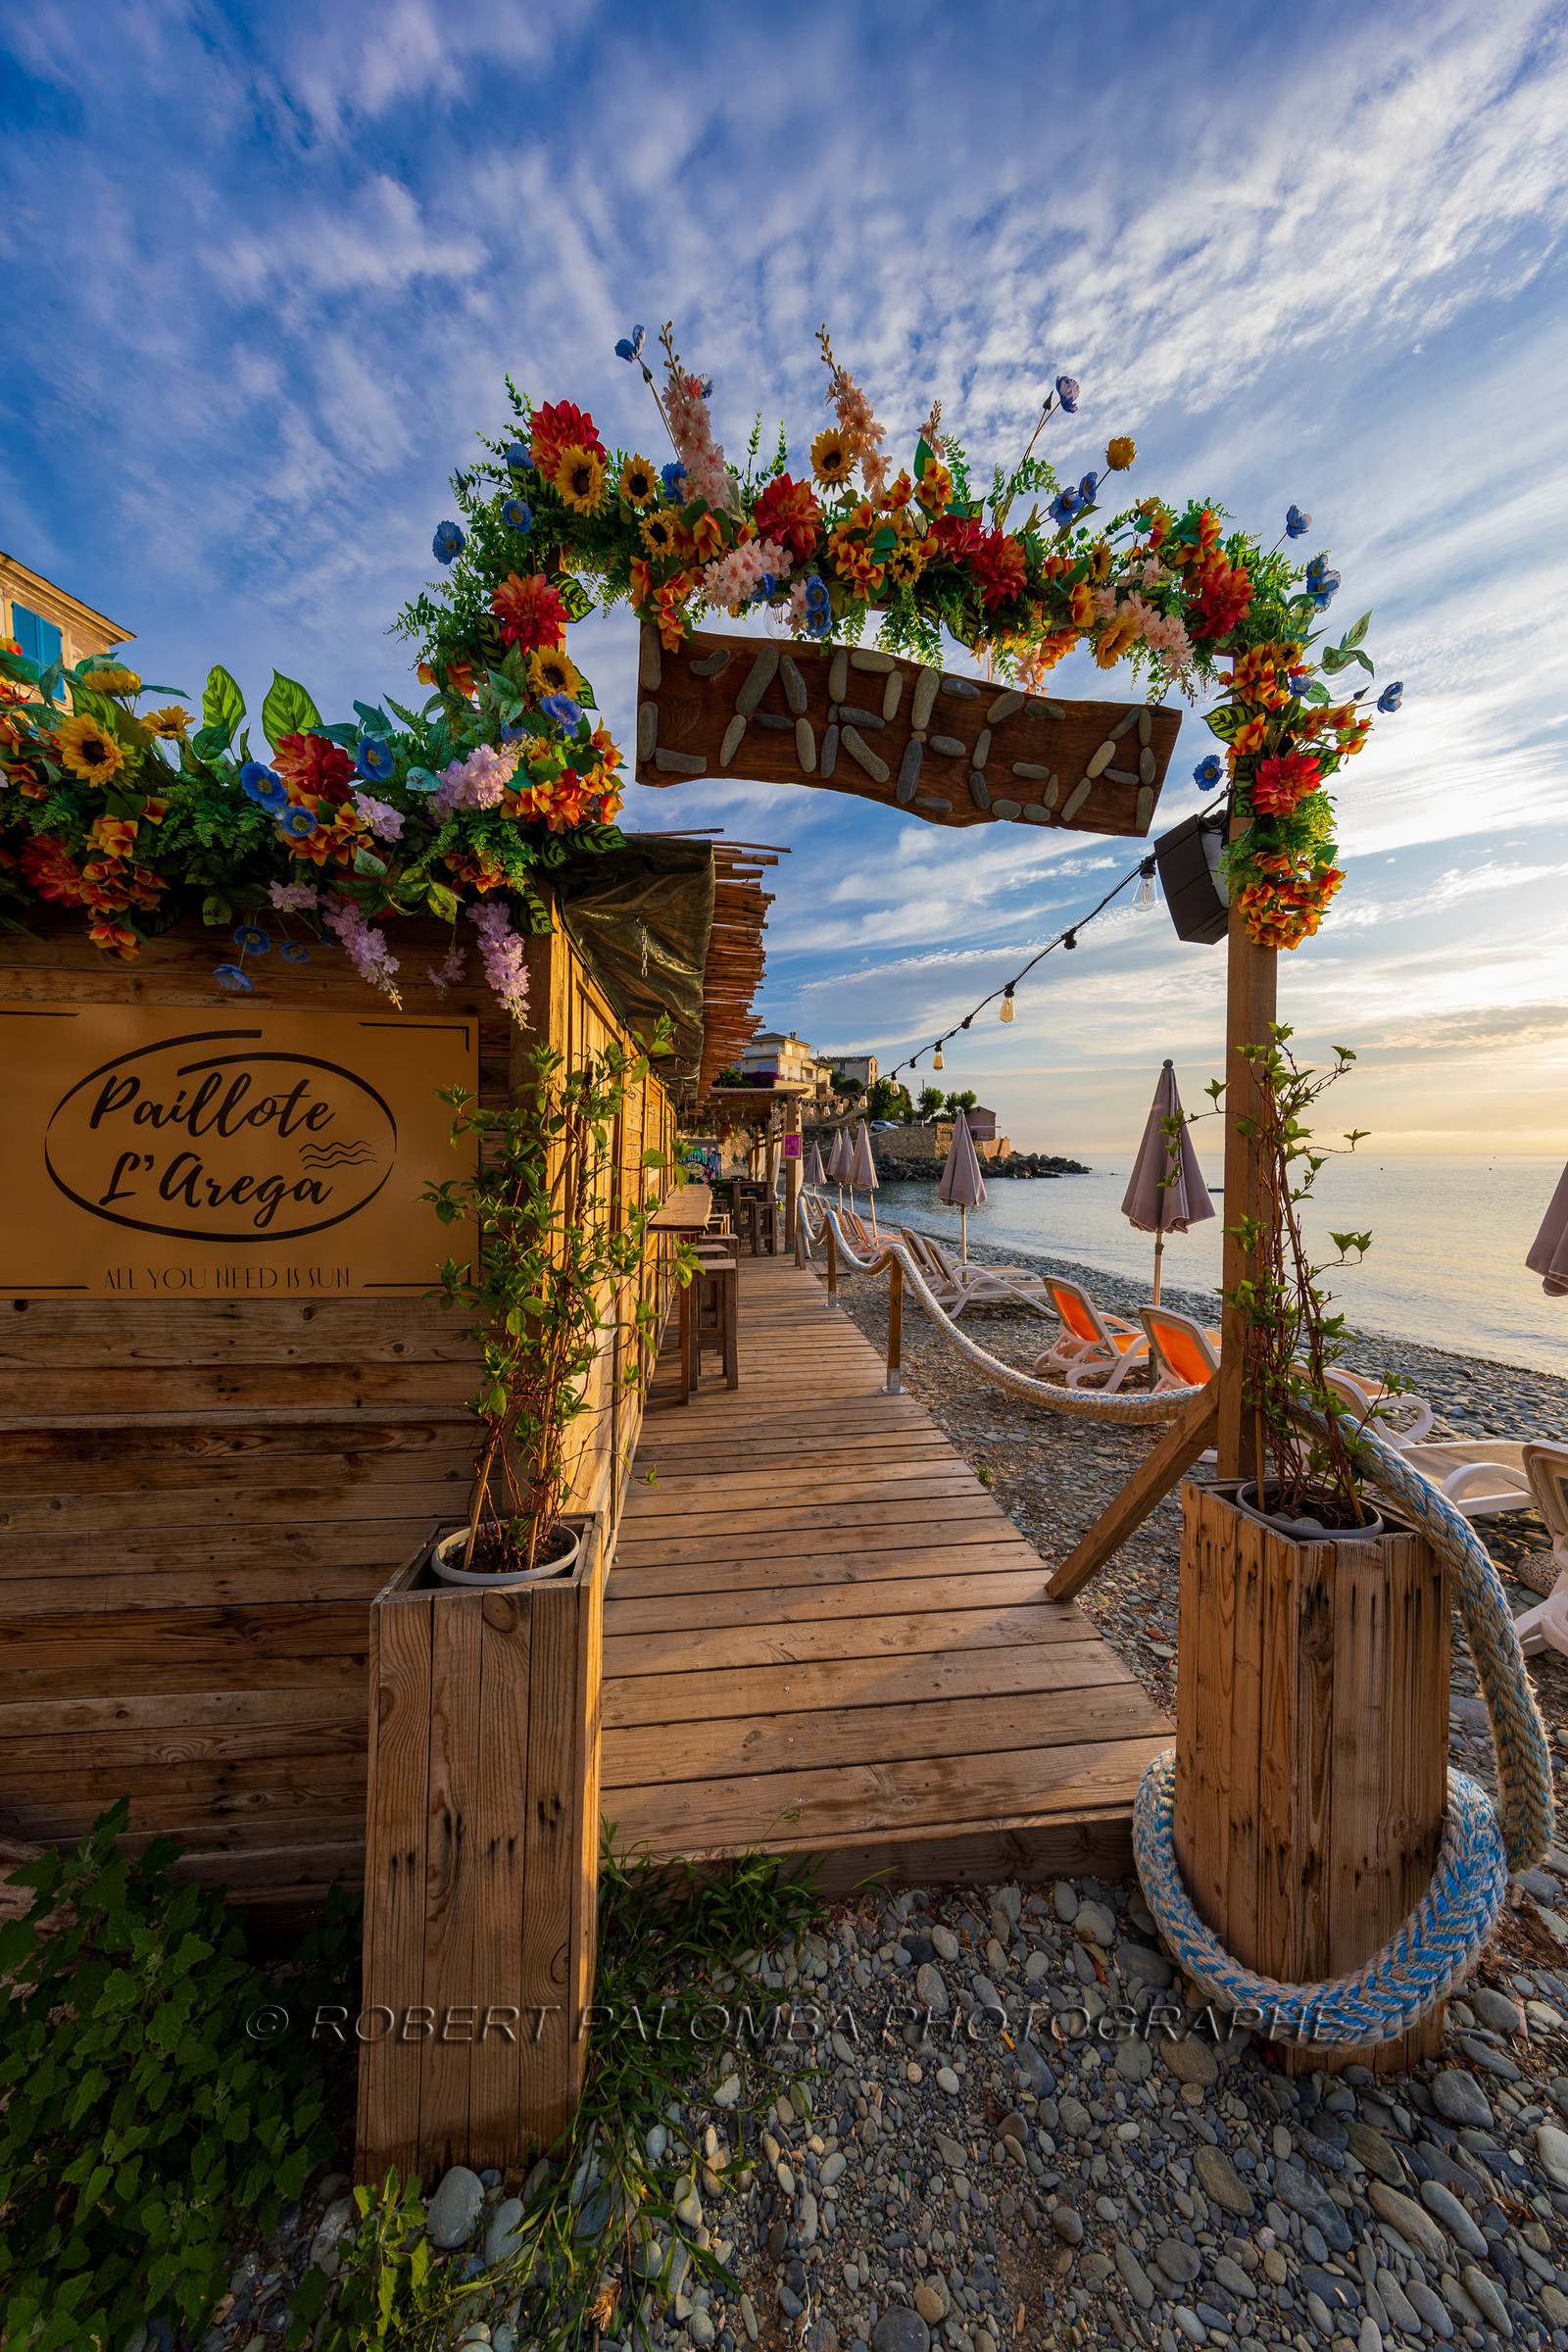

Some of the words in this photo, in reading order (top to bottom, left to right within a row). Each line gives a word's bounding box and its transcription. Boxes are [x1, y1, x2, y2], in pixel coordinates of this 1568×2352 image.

[90, 1072, 335, 1138] Paillote
[99, 1152, 333, 1228] L'Arega
[105, 1268, 139, 1290] ALL
[147, 1267, 207, 1290] YOU
[216, 1267, 278, 1290] NEED
[287, 1268, 300, 1289] IS
[309, 1267, 349, 1289] SUN
